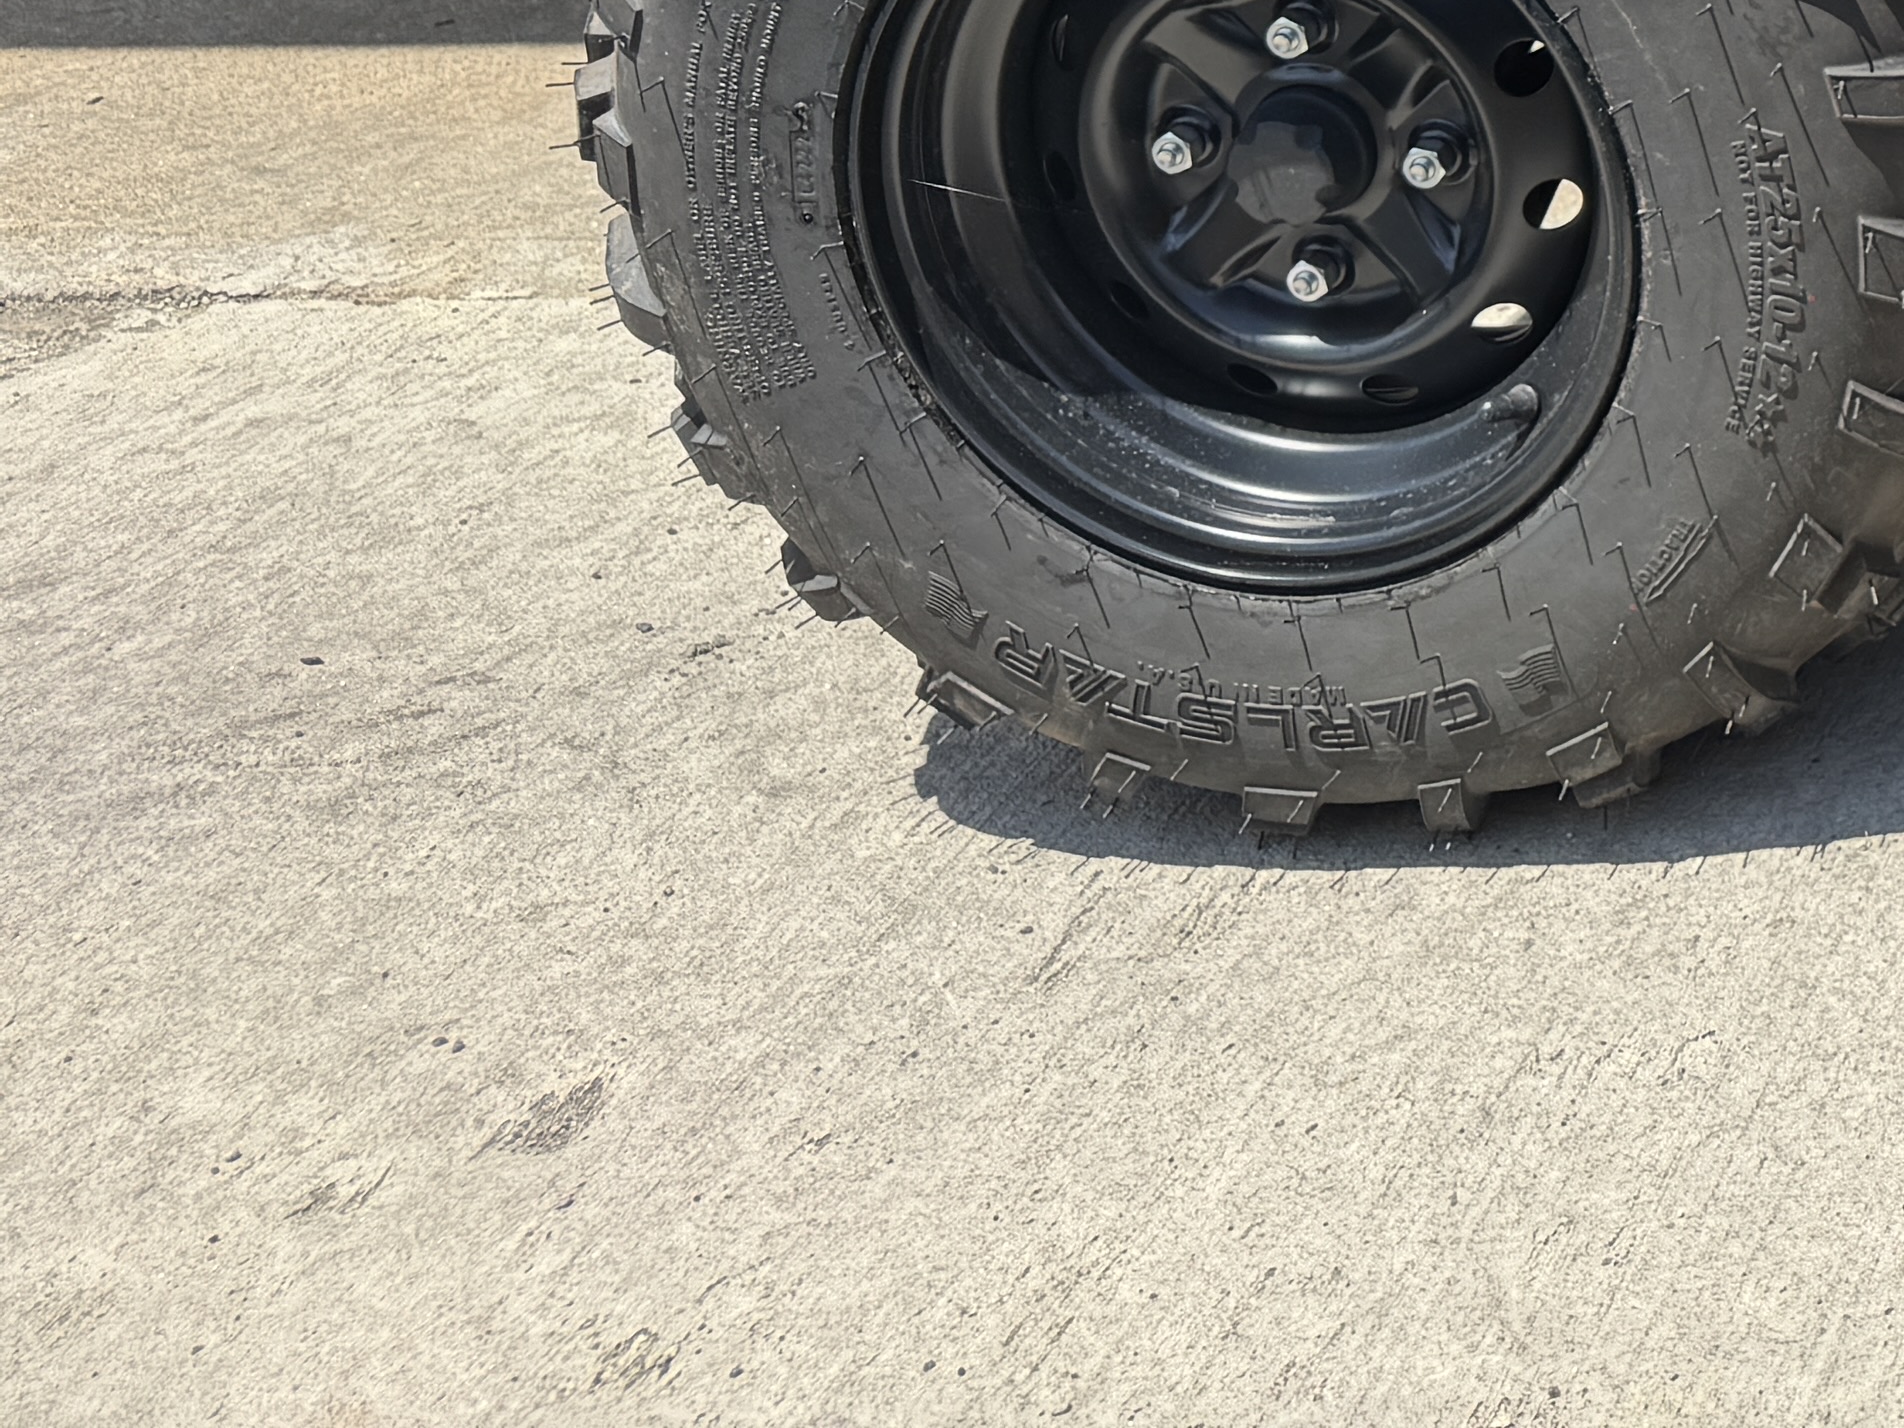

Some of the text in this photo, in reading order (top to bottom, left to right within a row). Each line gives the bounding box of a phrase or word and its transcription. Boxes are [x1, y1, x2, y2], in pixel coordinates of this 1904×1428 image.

[1723, 139, 1766, 435] NOT FOR HIGHWAY SERVICE
[994, 620, 1495, 753] CARLSTAR
